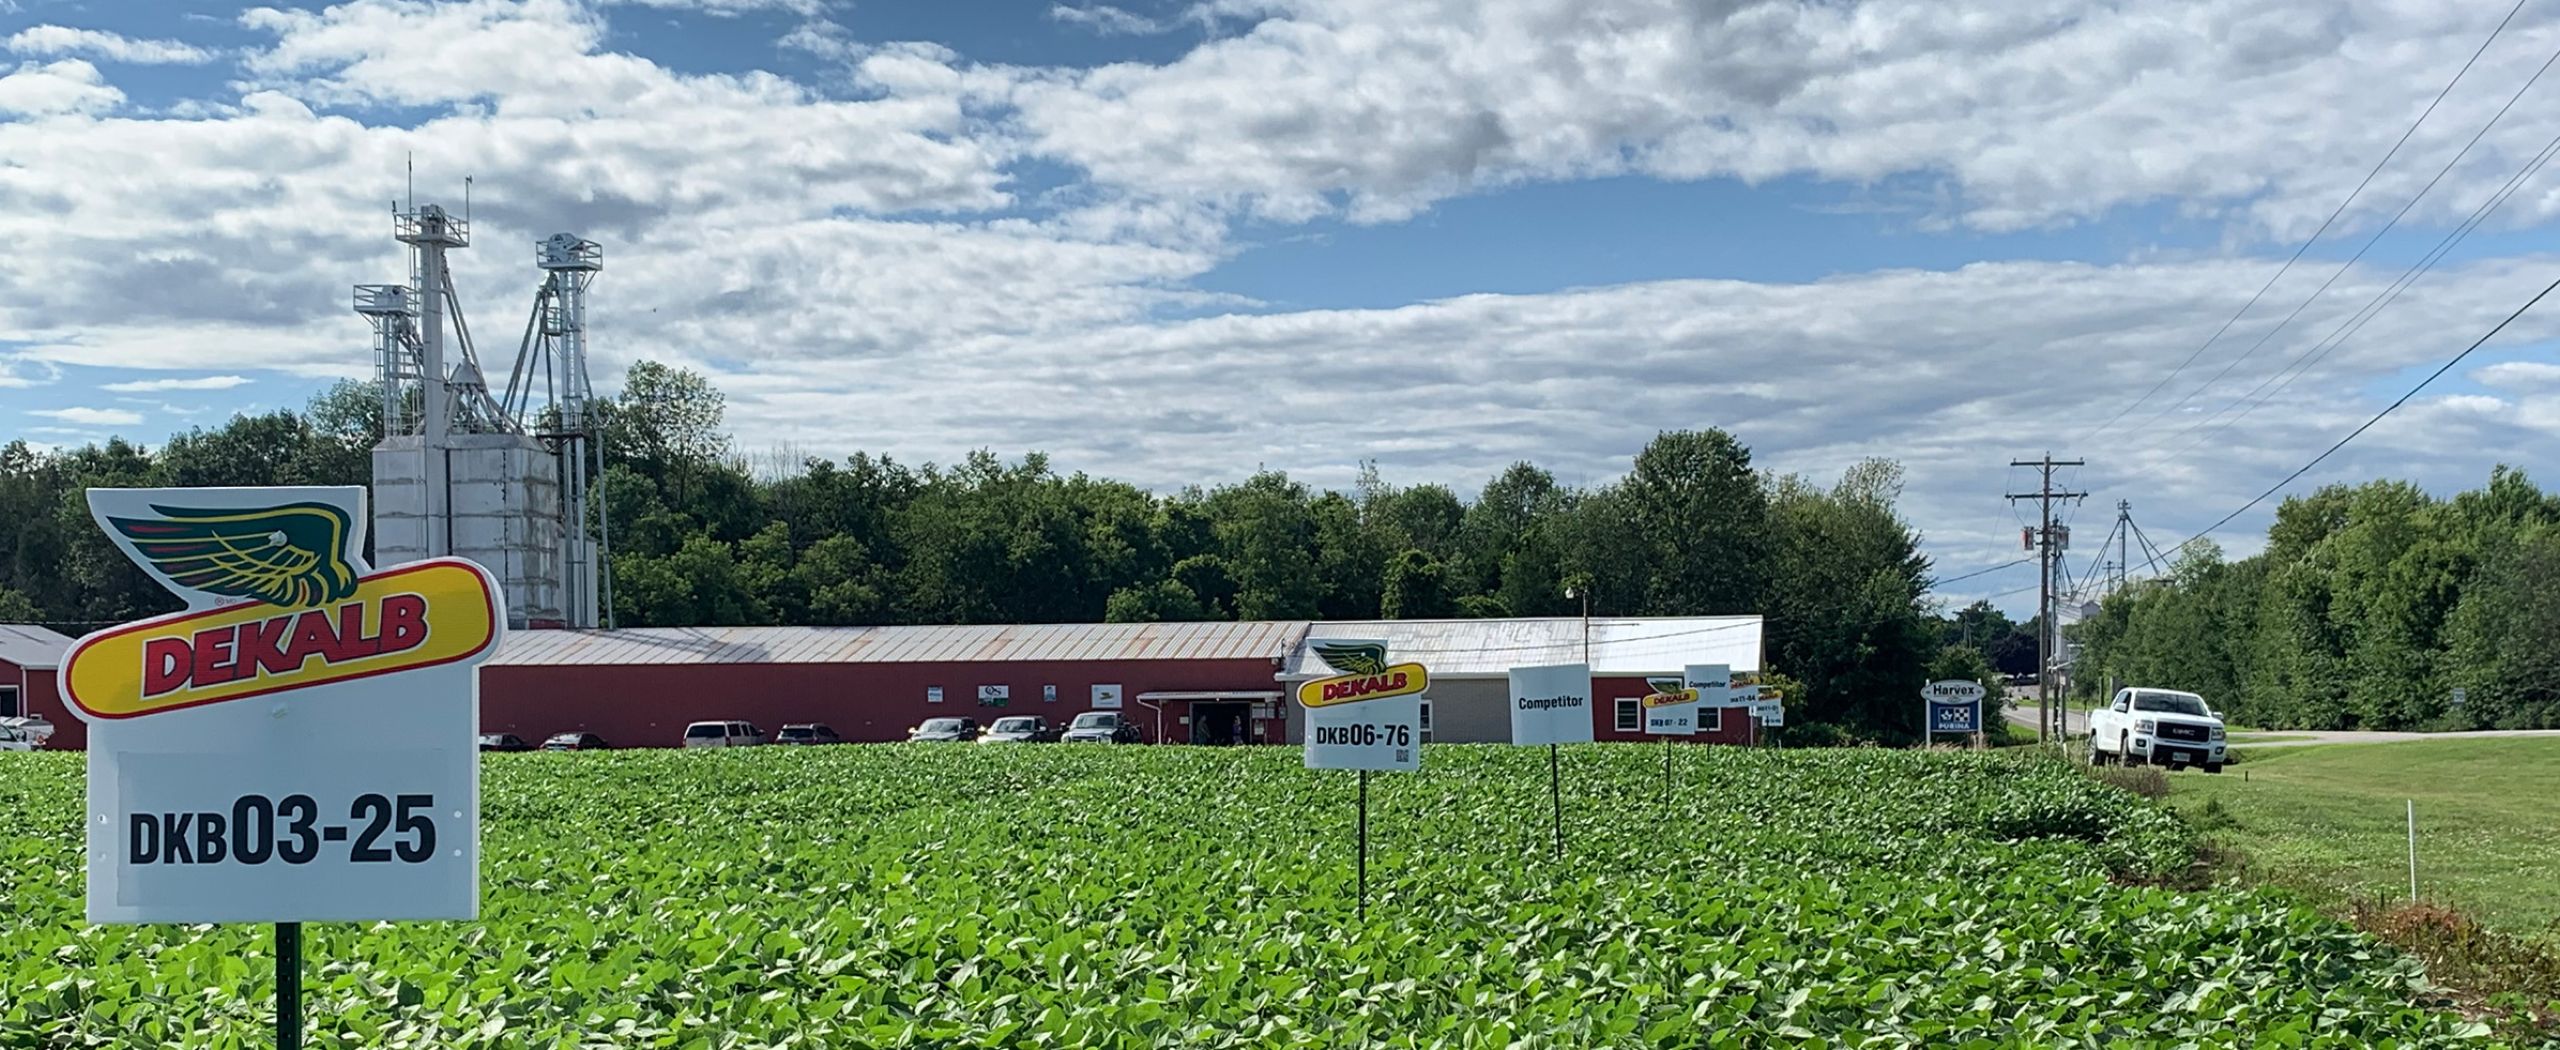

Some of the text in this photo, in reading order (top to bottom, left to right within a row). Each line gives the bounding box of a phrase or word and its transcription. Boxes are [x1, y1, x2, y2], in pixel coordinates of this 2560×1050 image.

[142, 593, 430, 698] DEKALB
[1322, 672, 1408, 702] DEKALB
[1688, 680, 1726, 689] Competitor
[1933, 684, 1975, 695] Harvex
[1518, 695, 1584, 711] Competitor
[1653, 693, 1690, 704] DEKALB
[1316, 723, 1410, 747] DKB06-76
[129, 793, 437, 865] DKB03-25
